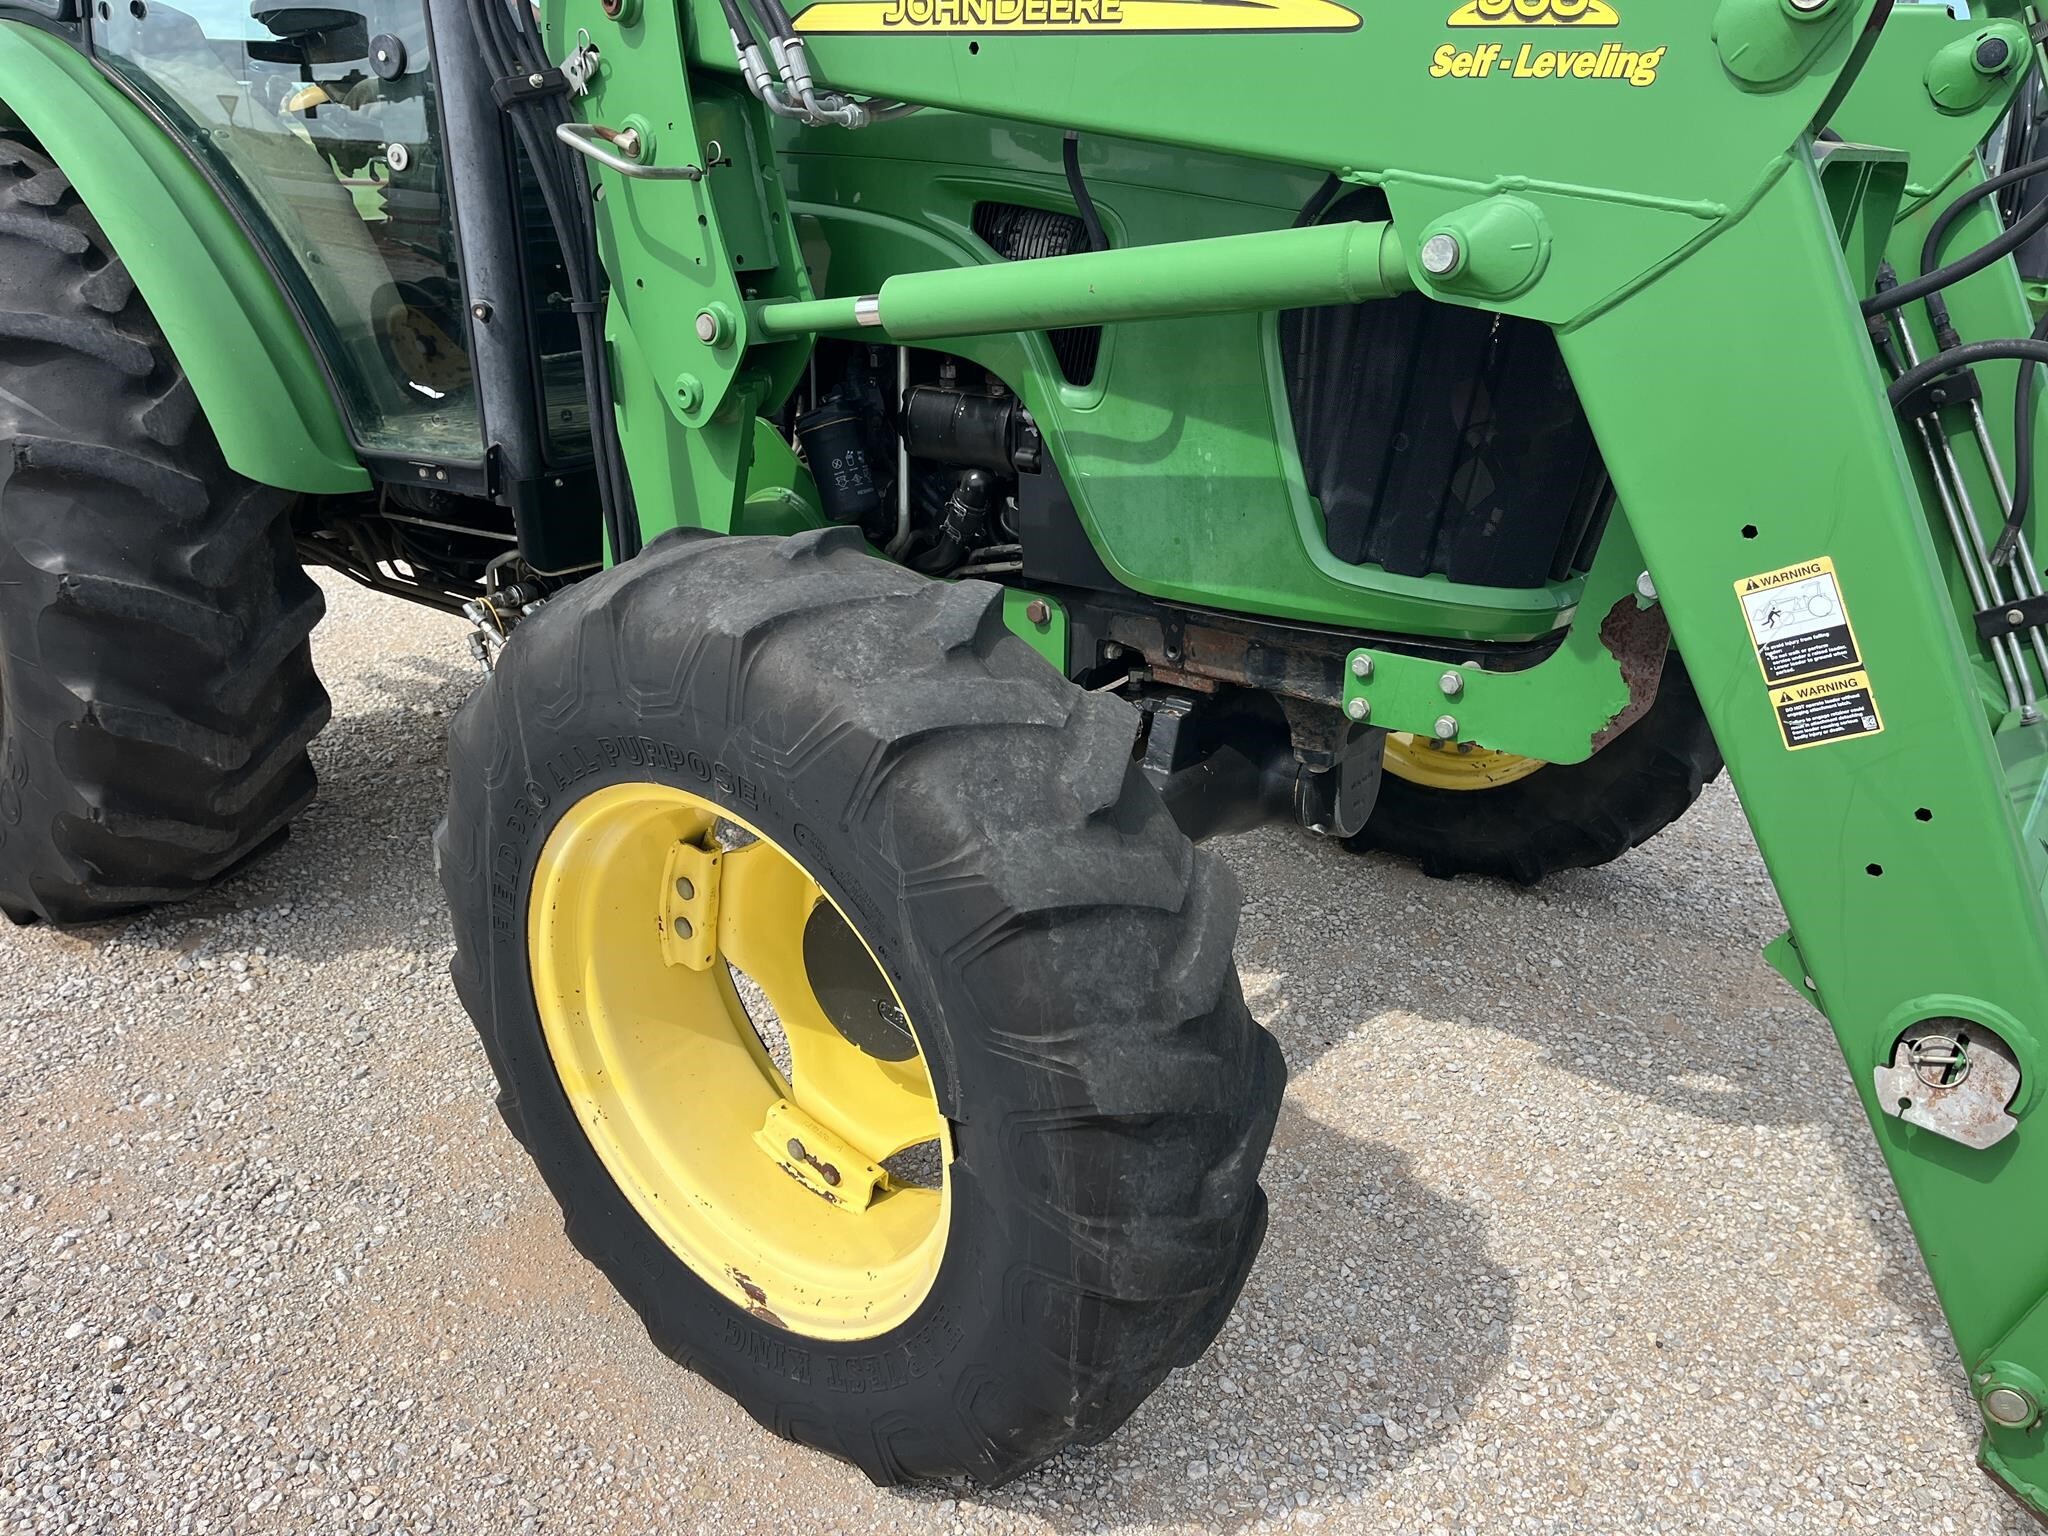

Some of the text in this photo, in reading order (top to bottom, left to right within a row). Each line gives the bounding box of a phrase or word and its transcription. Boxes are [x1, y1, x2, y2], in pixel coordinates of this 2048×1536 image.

[1760, 563, 1821, 587] WARNING
[1797, 678, 1858, 698] WARNING
[494, 842, 522, 939] FIELD
[545, 735, 760, 811] ALL-PURPOSE
